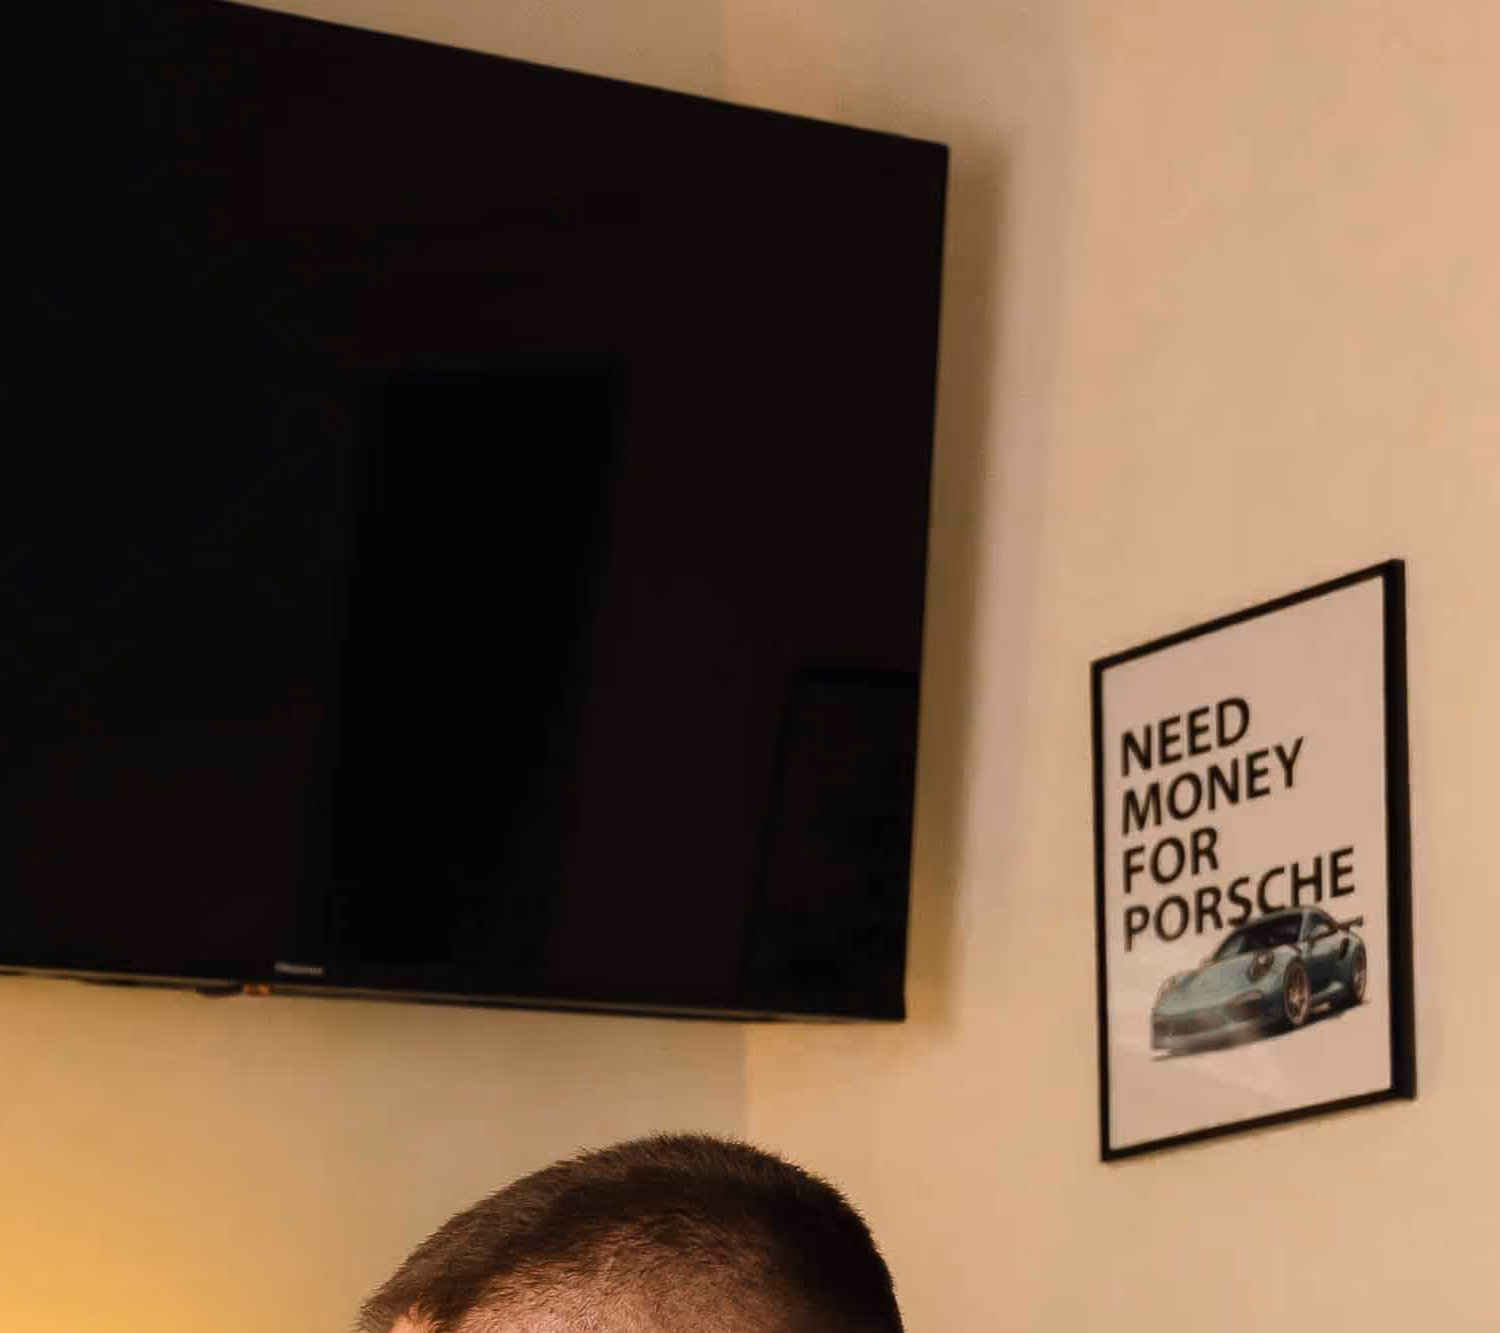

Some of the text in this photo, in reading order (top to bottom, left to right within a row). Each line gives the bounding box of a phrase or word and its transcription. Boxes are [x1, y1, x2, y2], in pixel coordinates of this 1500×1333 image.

[1120, 697, 1251, 778] NEED
[1121, 735, 1305, 838] MONEY
[1121, 826, 1219, 895] FOR
[1123, 845, 1357, 953] PORSCHE
